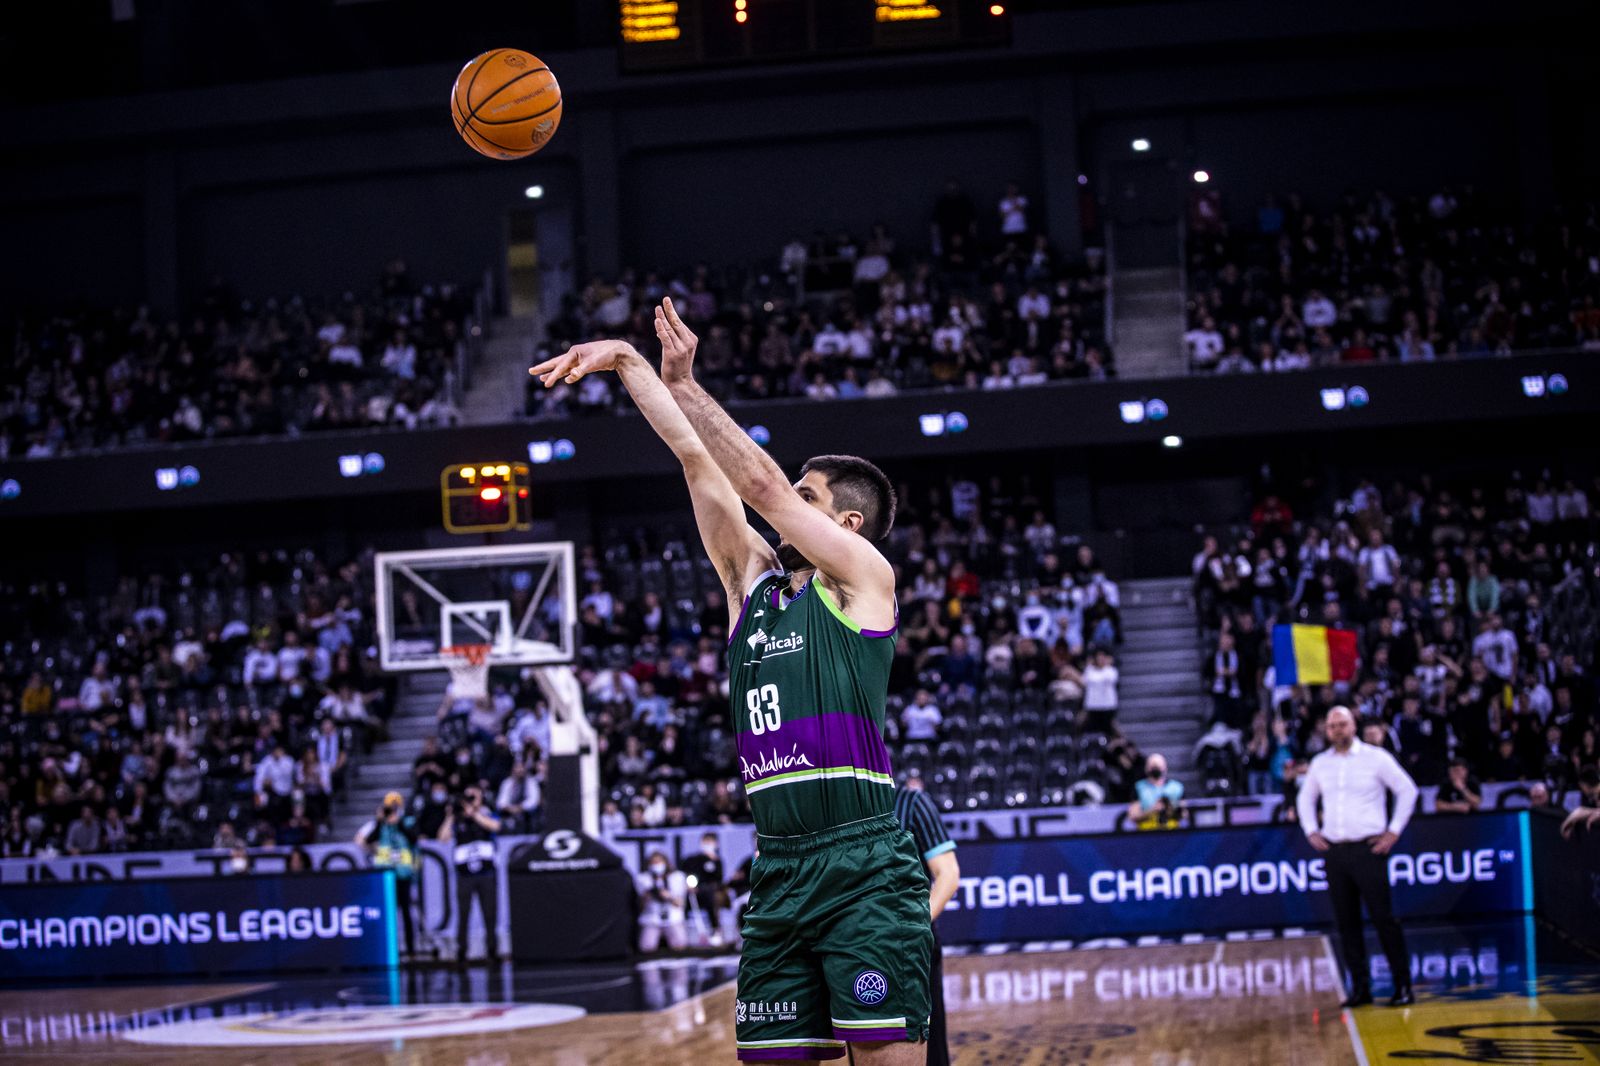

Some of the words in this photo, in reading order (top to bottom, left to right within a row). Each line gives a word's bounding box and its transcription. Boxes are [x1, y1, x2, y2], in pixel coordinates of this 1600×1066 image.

[764, 631, 804, 652] nicaja
[746, 683, 781, 736] 83
[740, 742, 815, 781] Andalucía
[1089, 858, 1329, 903] CHAMPIONS
[1387, 848, 1496, 887] AGUE
[0, 911, 212, 949] CHAMPIONS
[216, 905, 363, 942] LEAGUE
[749, 1000, 797, 1012] MÁLAGA
